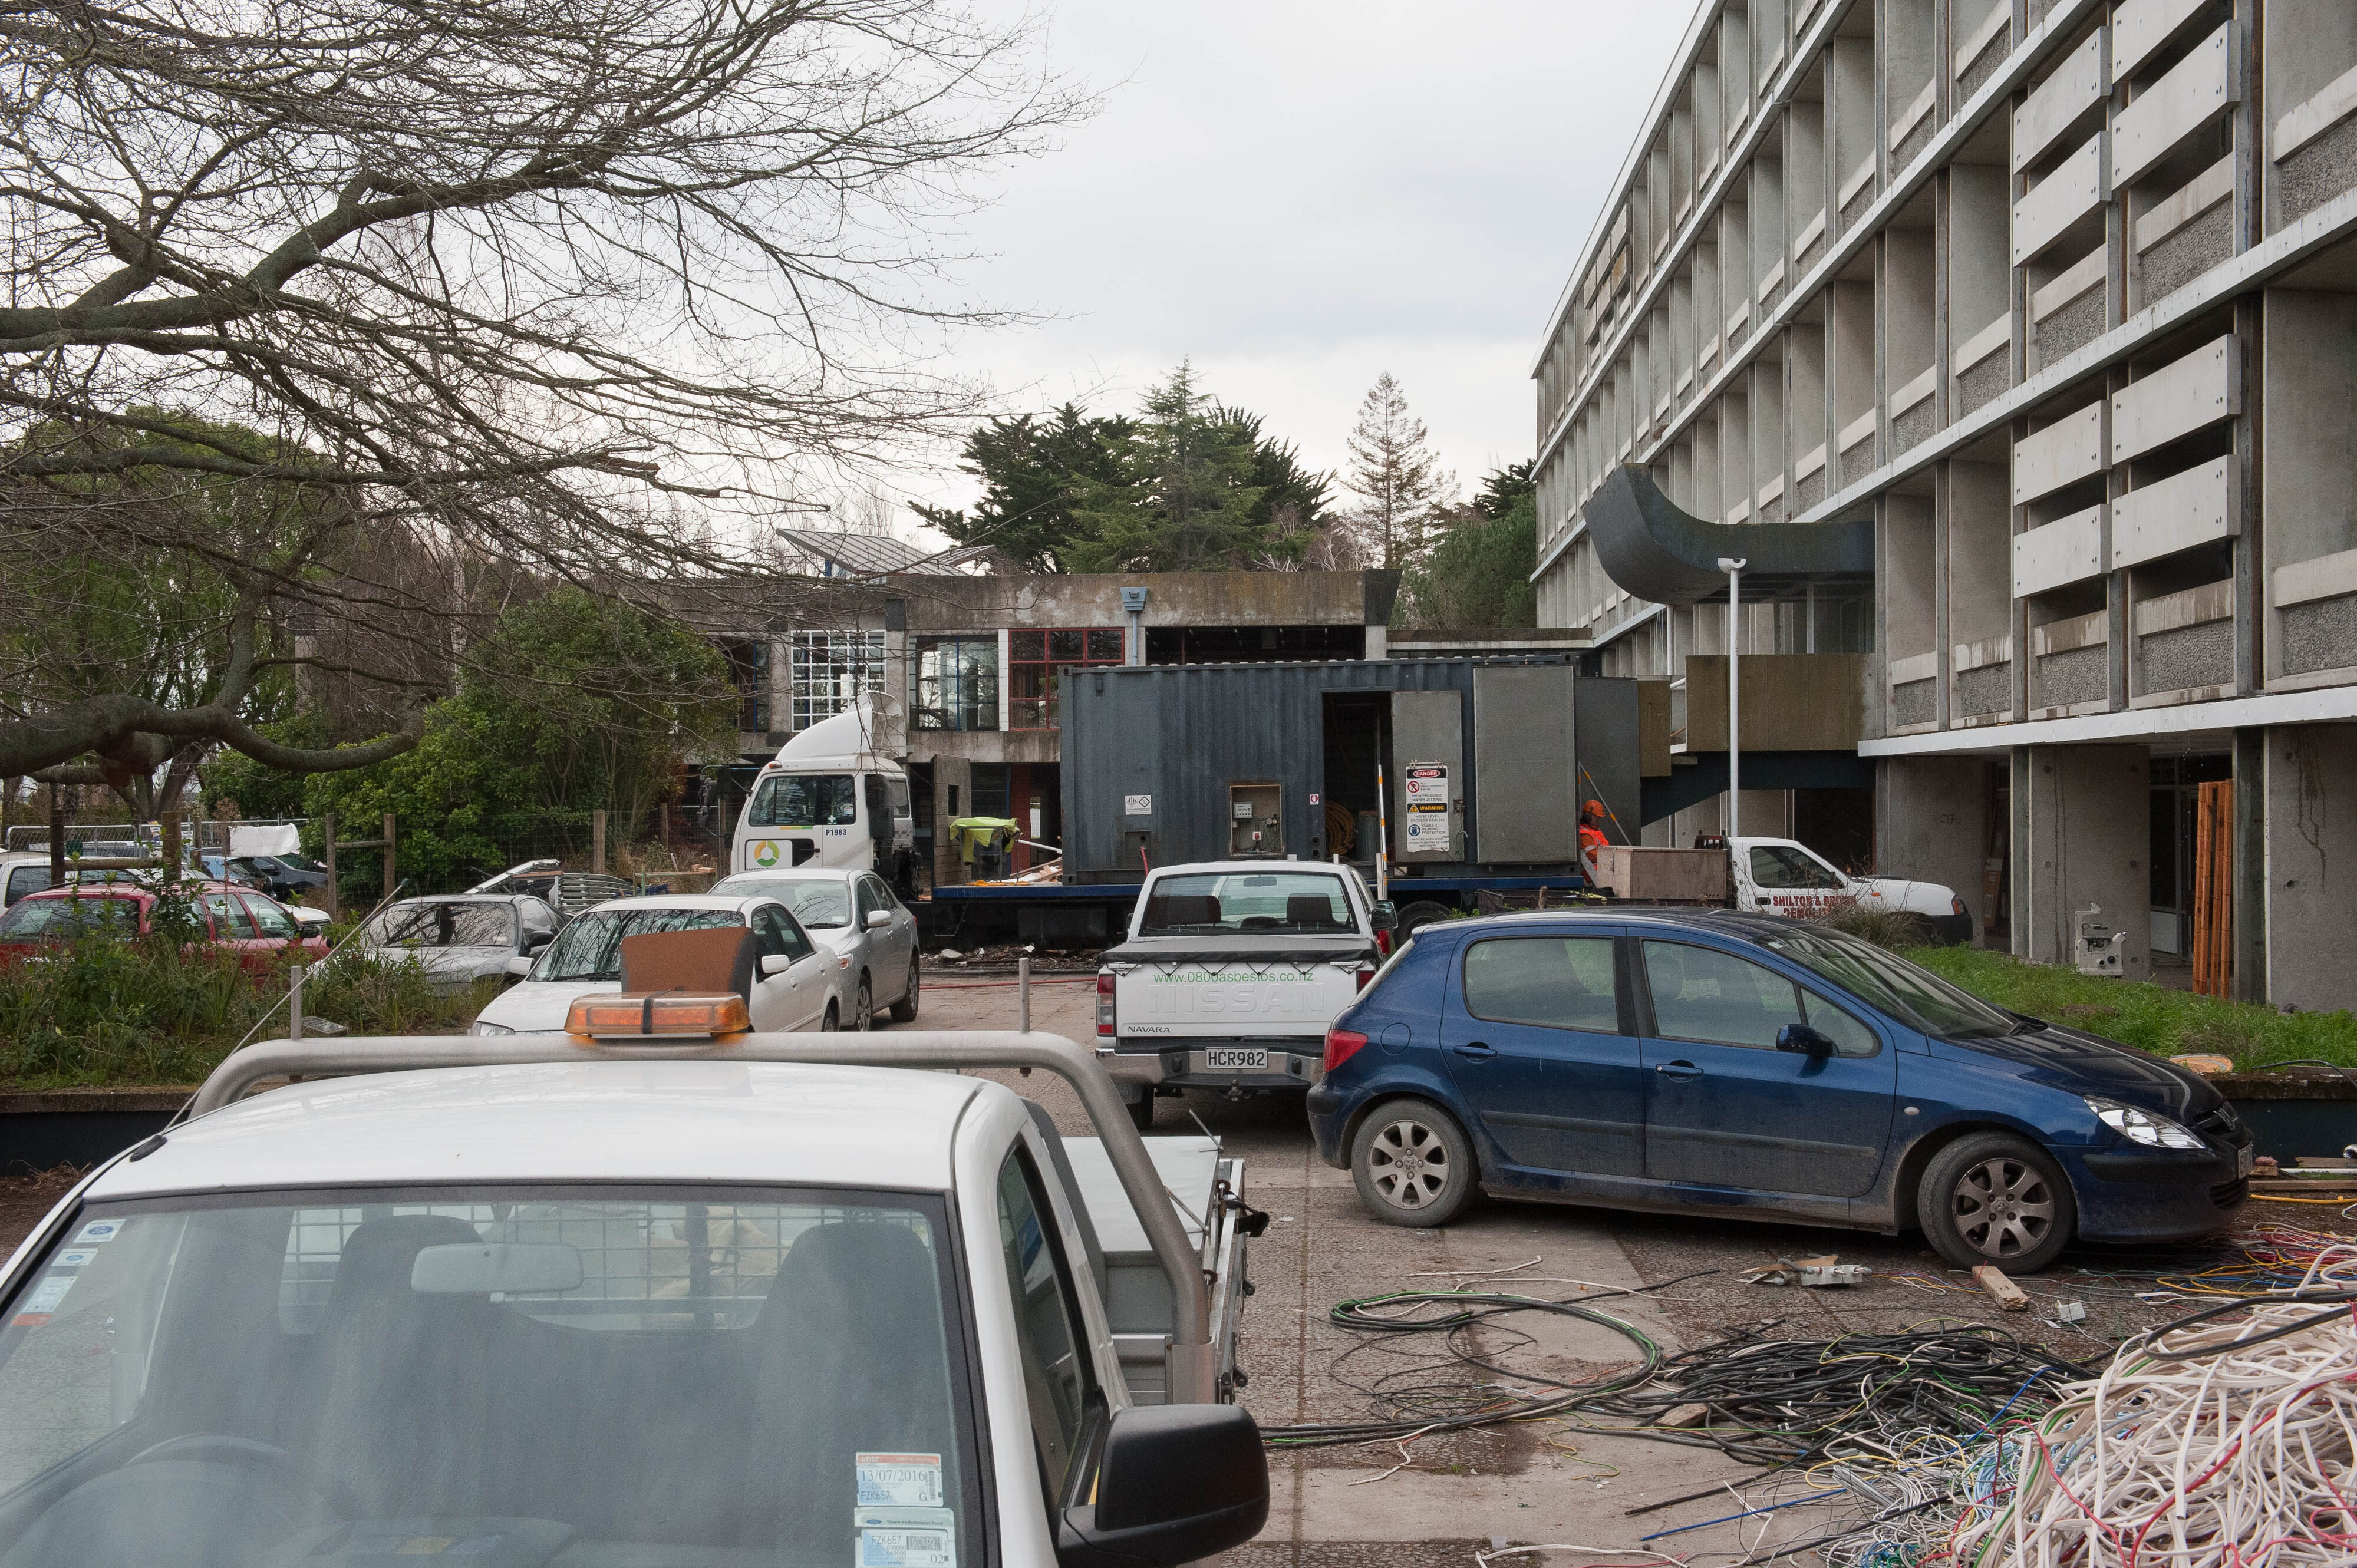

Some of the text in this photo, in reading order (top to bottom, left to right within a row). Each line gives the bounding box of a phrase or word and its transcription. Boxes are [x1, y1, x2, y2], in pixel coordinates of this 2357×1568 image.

[1773, 896, 1812, 906] SHILTON
[1815, 896, 1822, 906] &
[1153, 971, 1314, 983] www.0800asbestos.co.nz
[1148, 983, 1324, 1013] NISSAN
[1208, 1051, 1266, 1067] HCR982
[861, 1470, 925, 1481] 13/07/2016
[861, 1491, 891, 1500] FZK657
[919, 1492, 927, 1501] G
[871, 1535, 902, 1544] FZK657
[930, 1554, 944, 1564] 02
